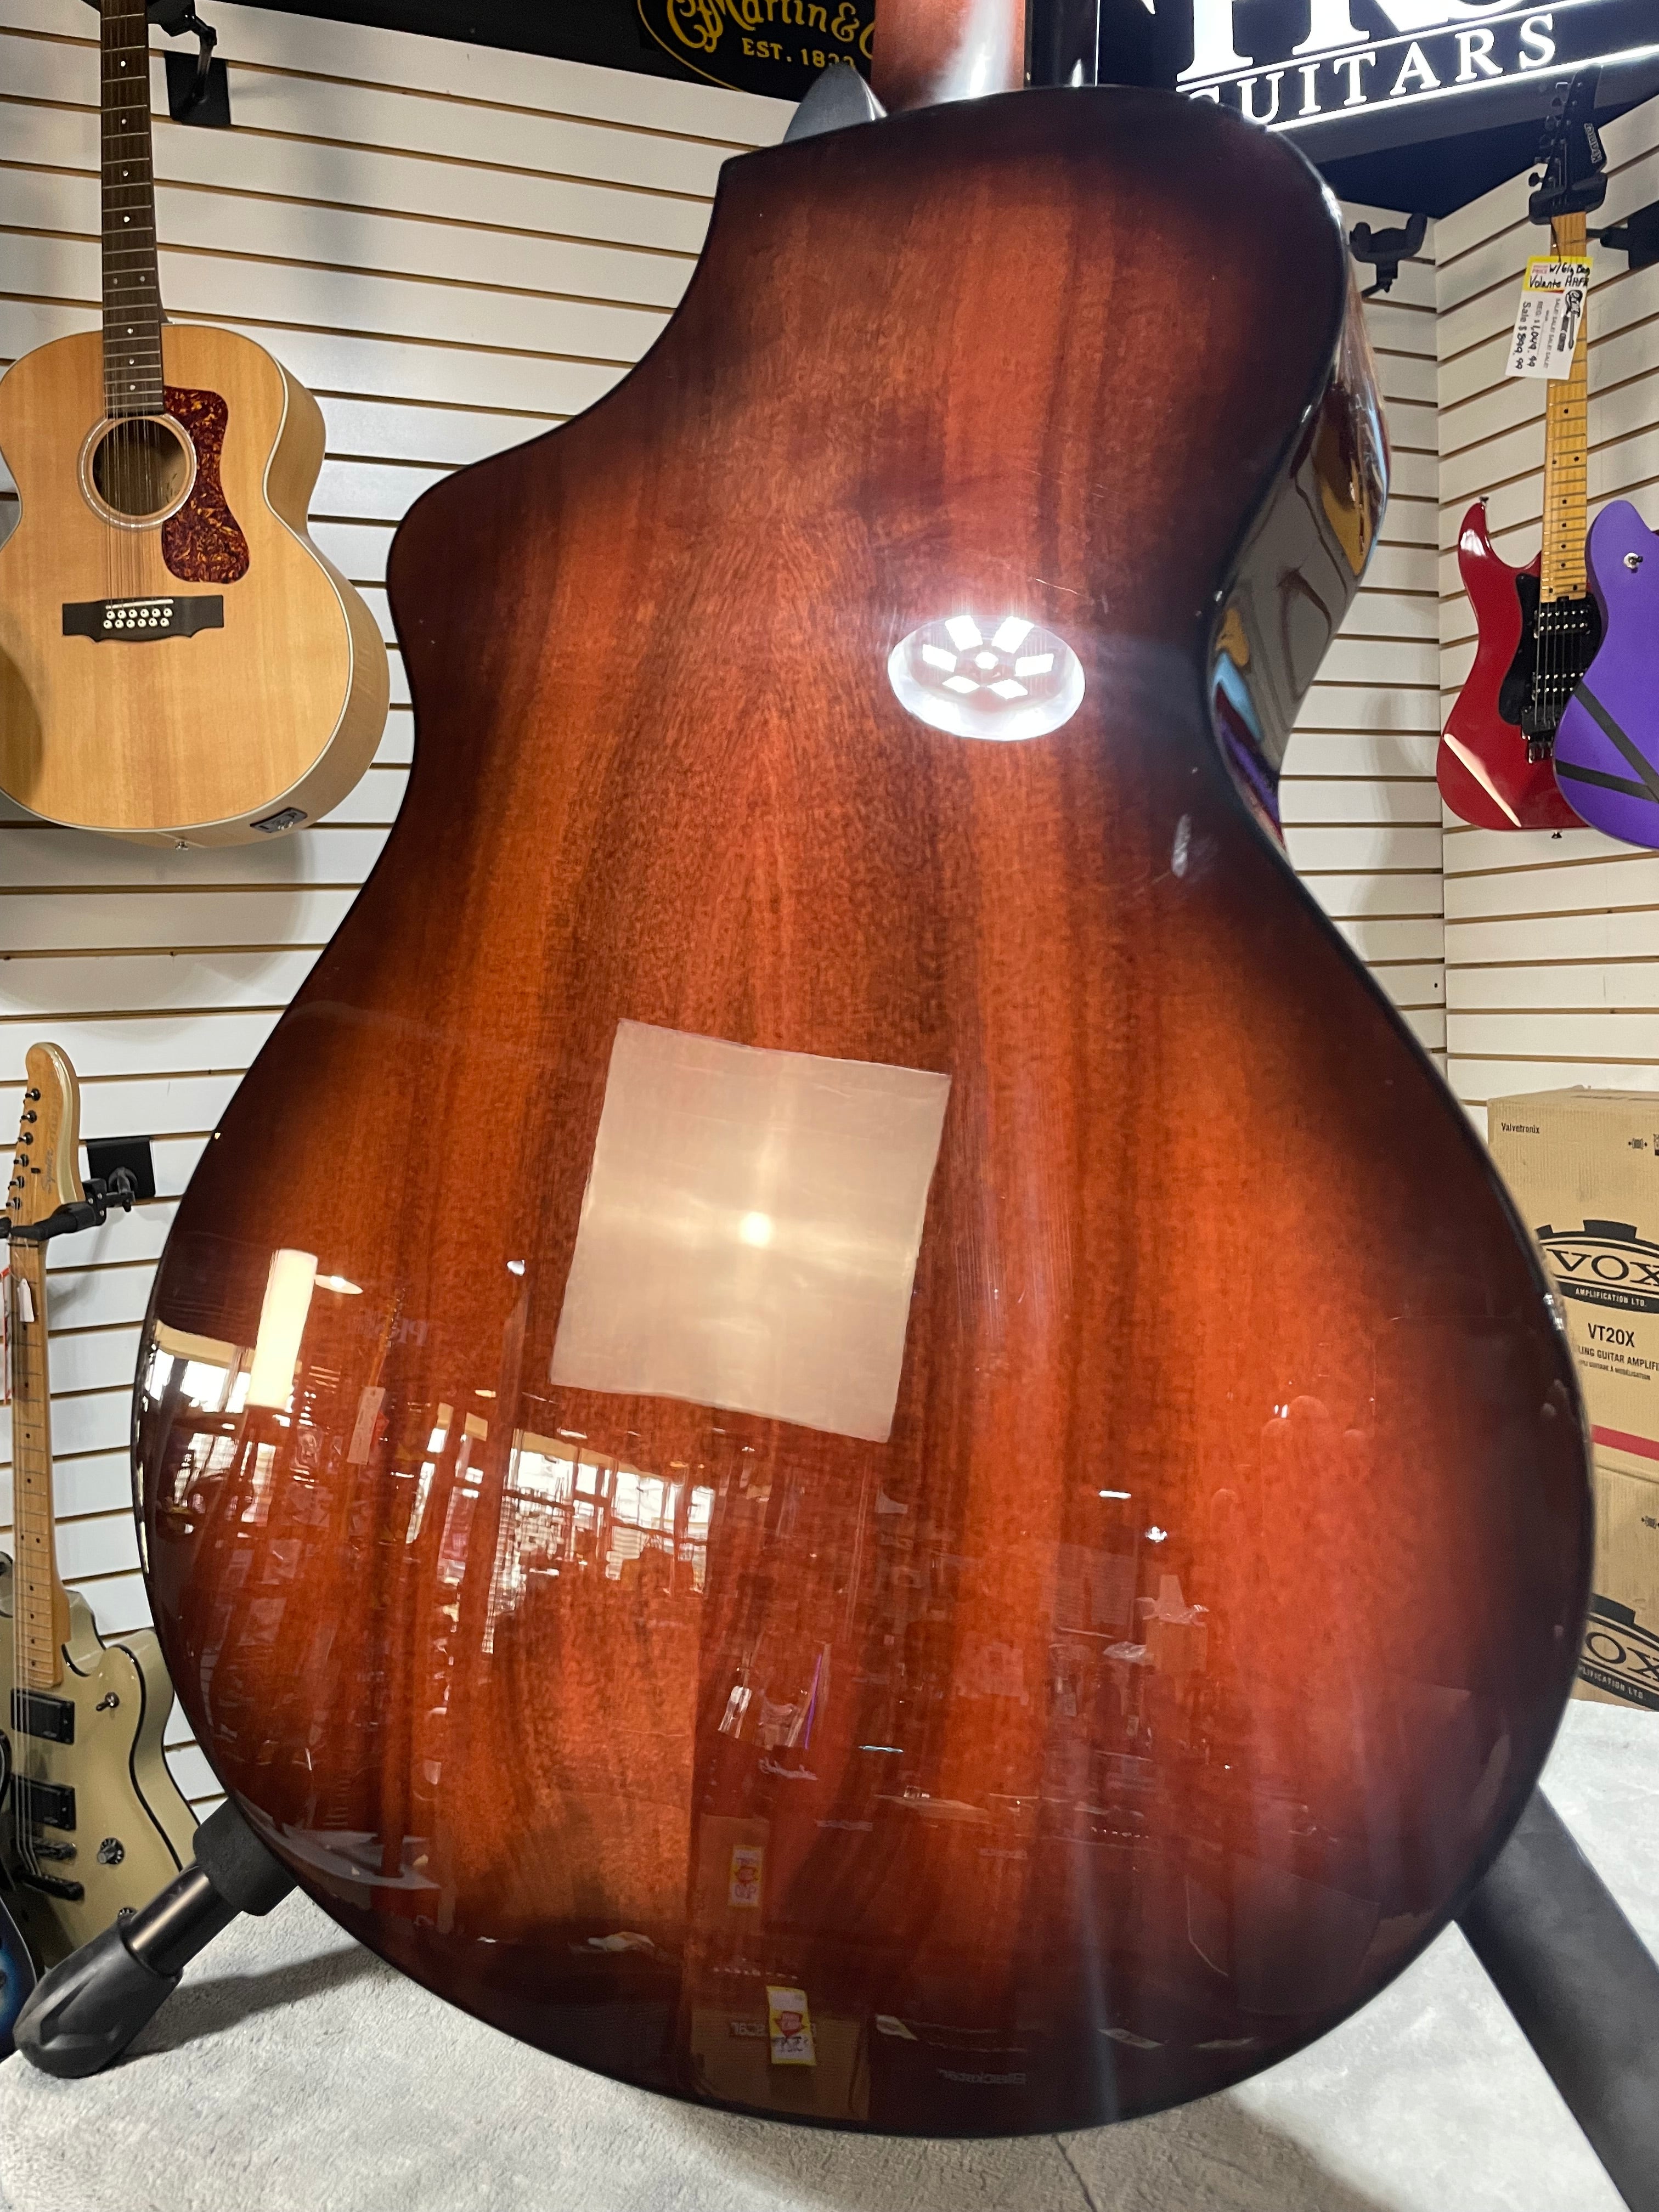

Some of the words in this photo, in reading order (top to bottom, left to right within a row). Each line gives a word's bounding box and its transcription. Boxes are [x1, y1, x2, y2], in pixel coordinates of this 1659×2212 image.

[742, 38, 792, 62] EST.
[1520, 302, 1531, 323] Sale
[1501, 1122, 1540, 1135] Valvetronix
[1575, 1288, 1628, 1304] AMPLIFICATION
[1588, 1322, 1635, 1348] VT20X
[1577, 1345, 1595, 1357] LING
[1596, 1348, 1625, 1363] GUITAR
[1585, 1632, 1659, 1683] OX
